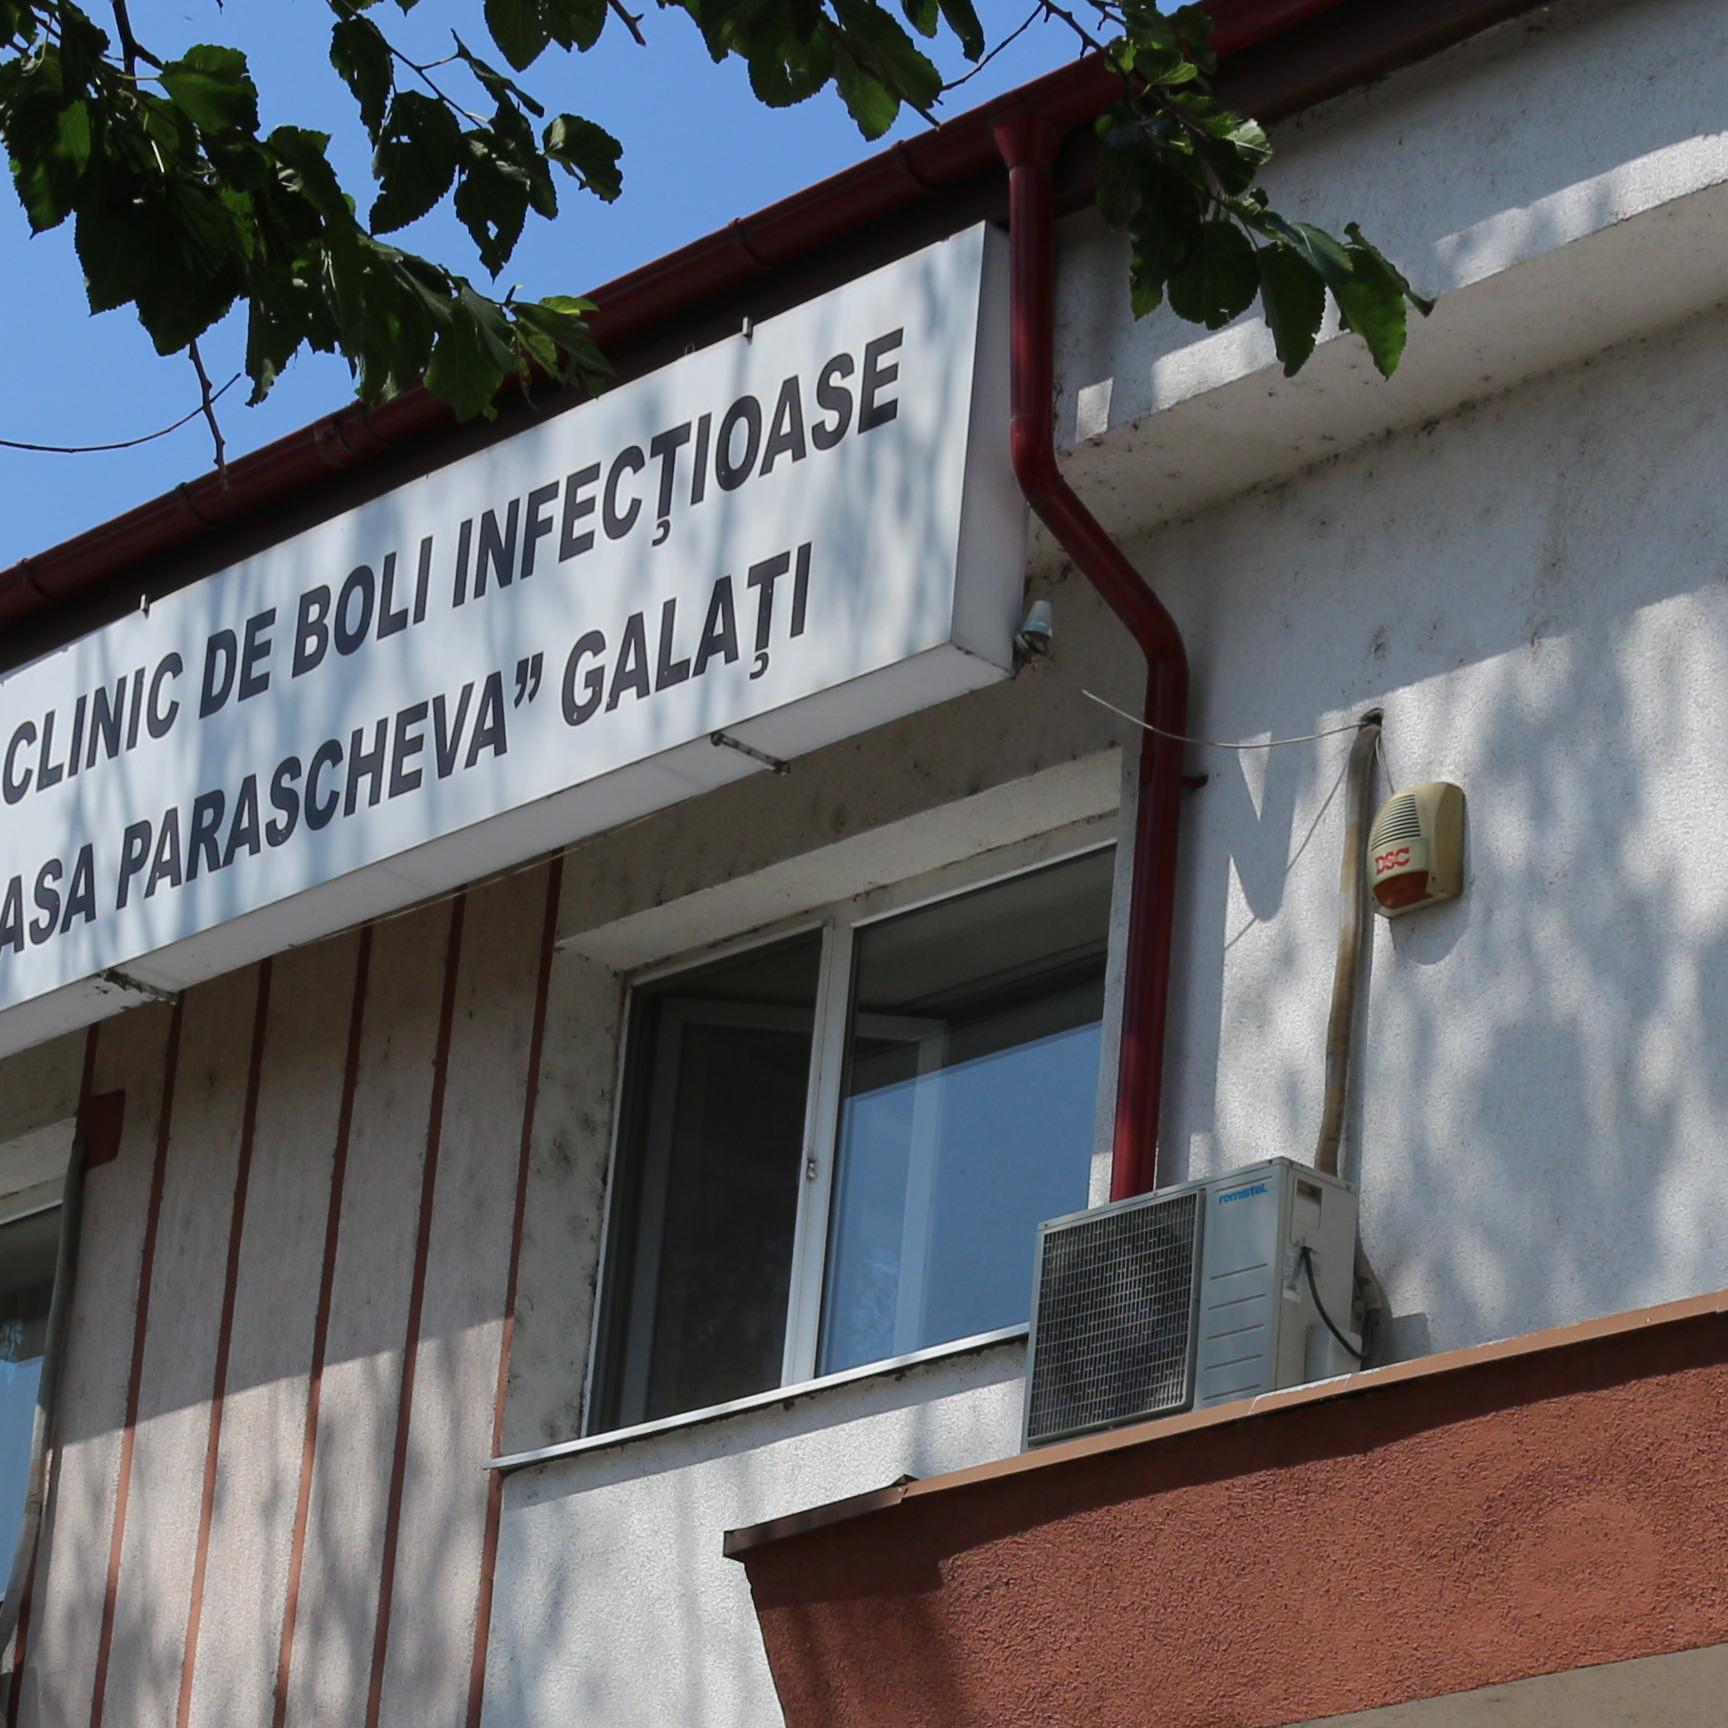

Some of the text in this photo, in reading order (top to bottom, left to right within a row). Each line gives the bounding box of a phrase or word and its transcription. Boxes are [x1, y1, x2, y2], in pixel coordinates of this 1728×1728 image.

[2, 651, 184, 806] CLINIC
[199, 606, 276, 720] DE
[292, 536, 432, 679] BOLI
